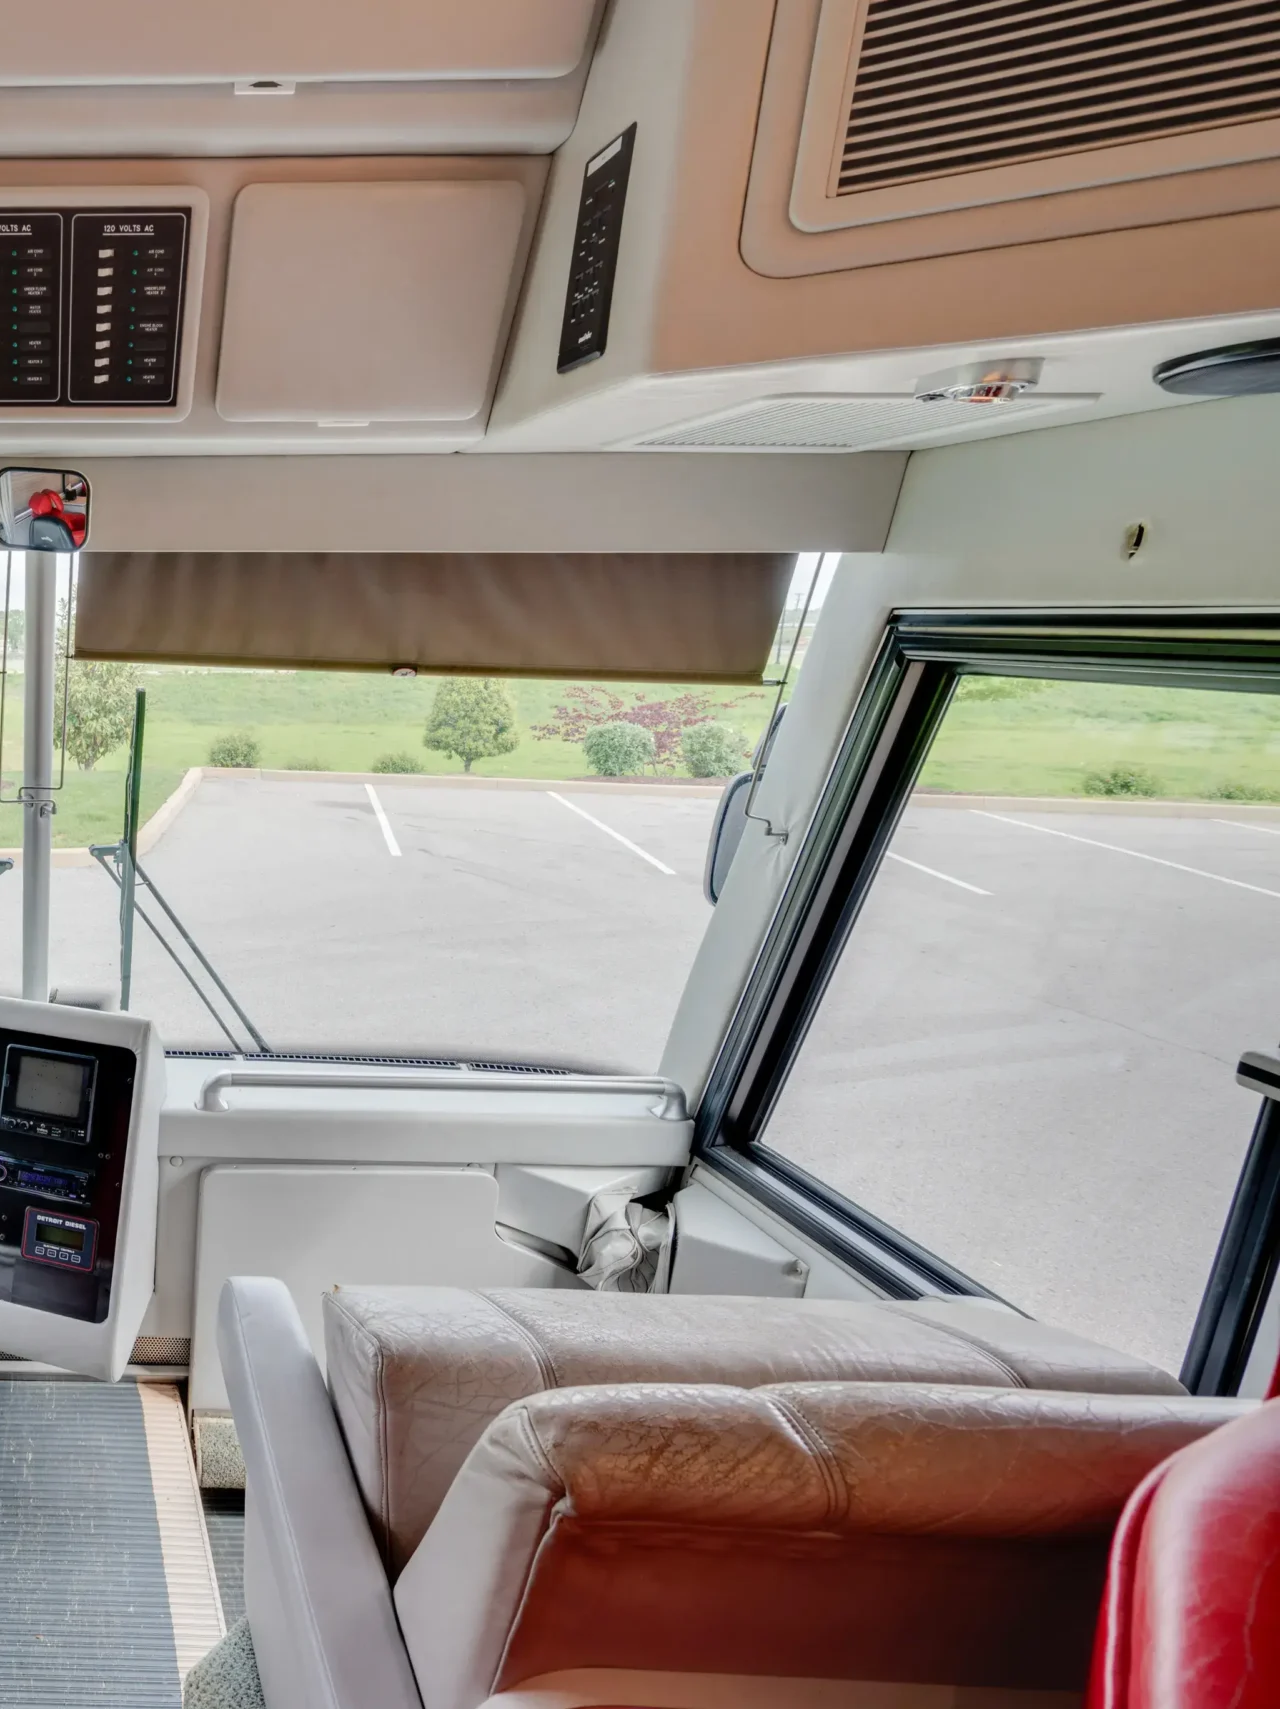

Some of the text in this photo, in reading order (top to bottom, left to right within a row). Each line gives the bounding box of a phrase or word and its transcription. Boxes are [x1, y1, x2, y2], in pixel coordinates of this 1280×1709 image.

[22, 224, 31, 232] AC
[103, 224, 154, 232] 120 VOLTS AC
[36, 1214, 86, 1230] DETROIT DIESEL
